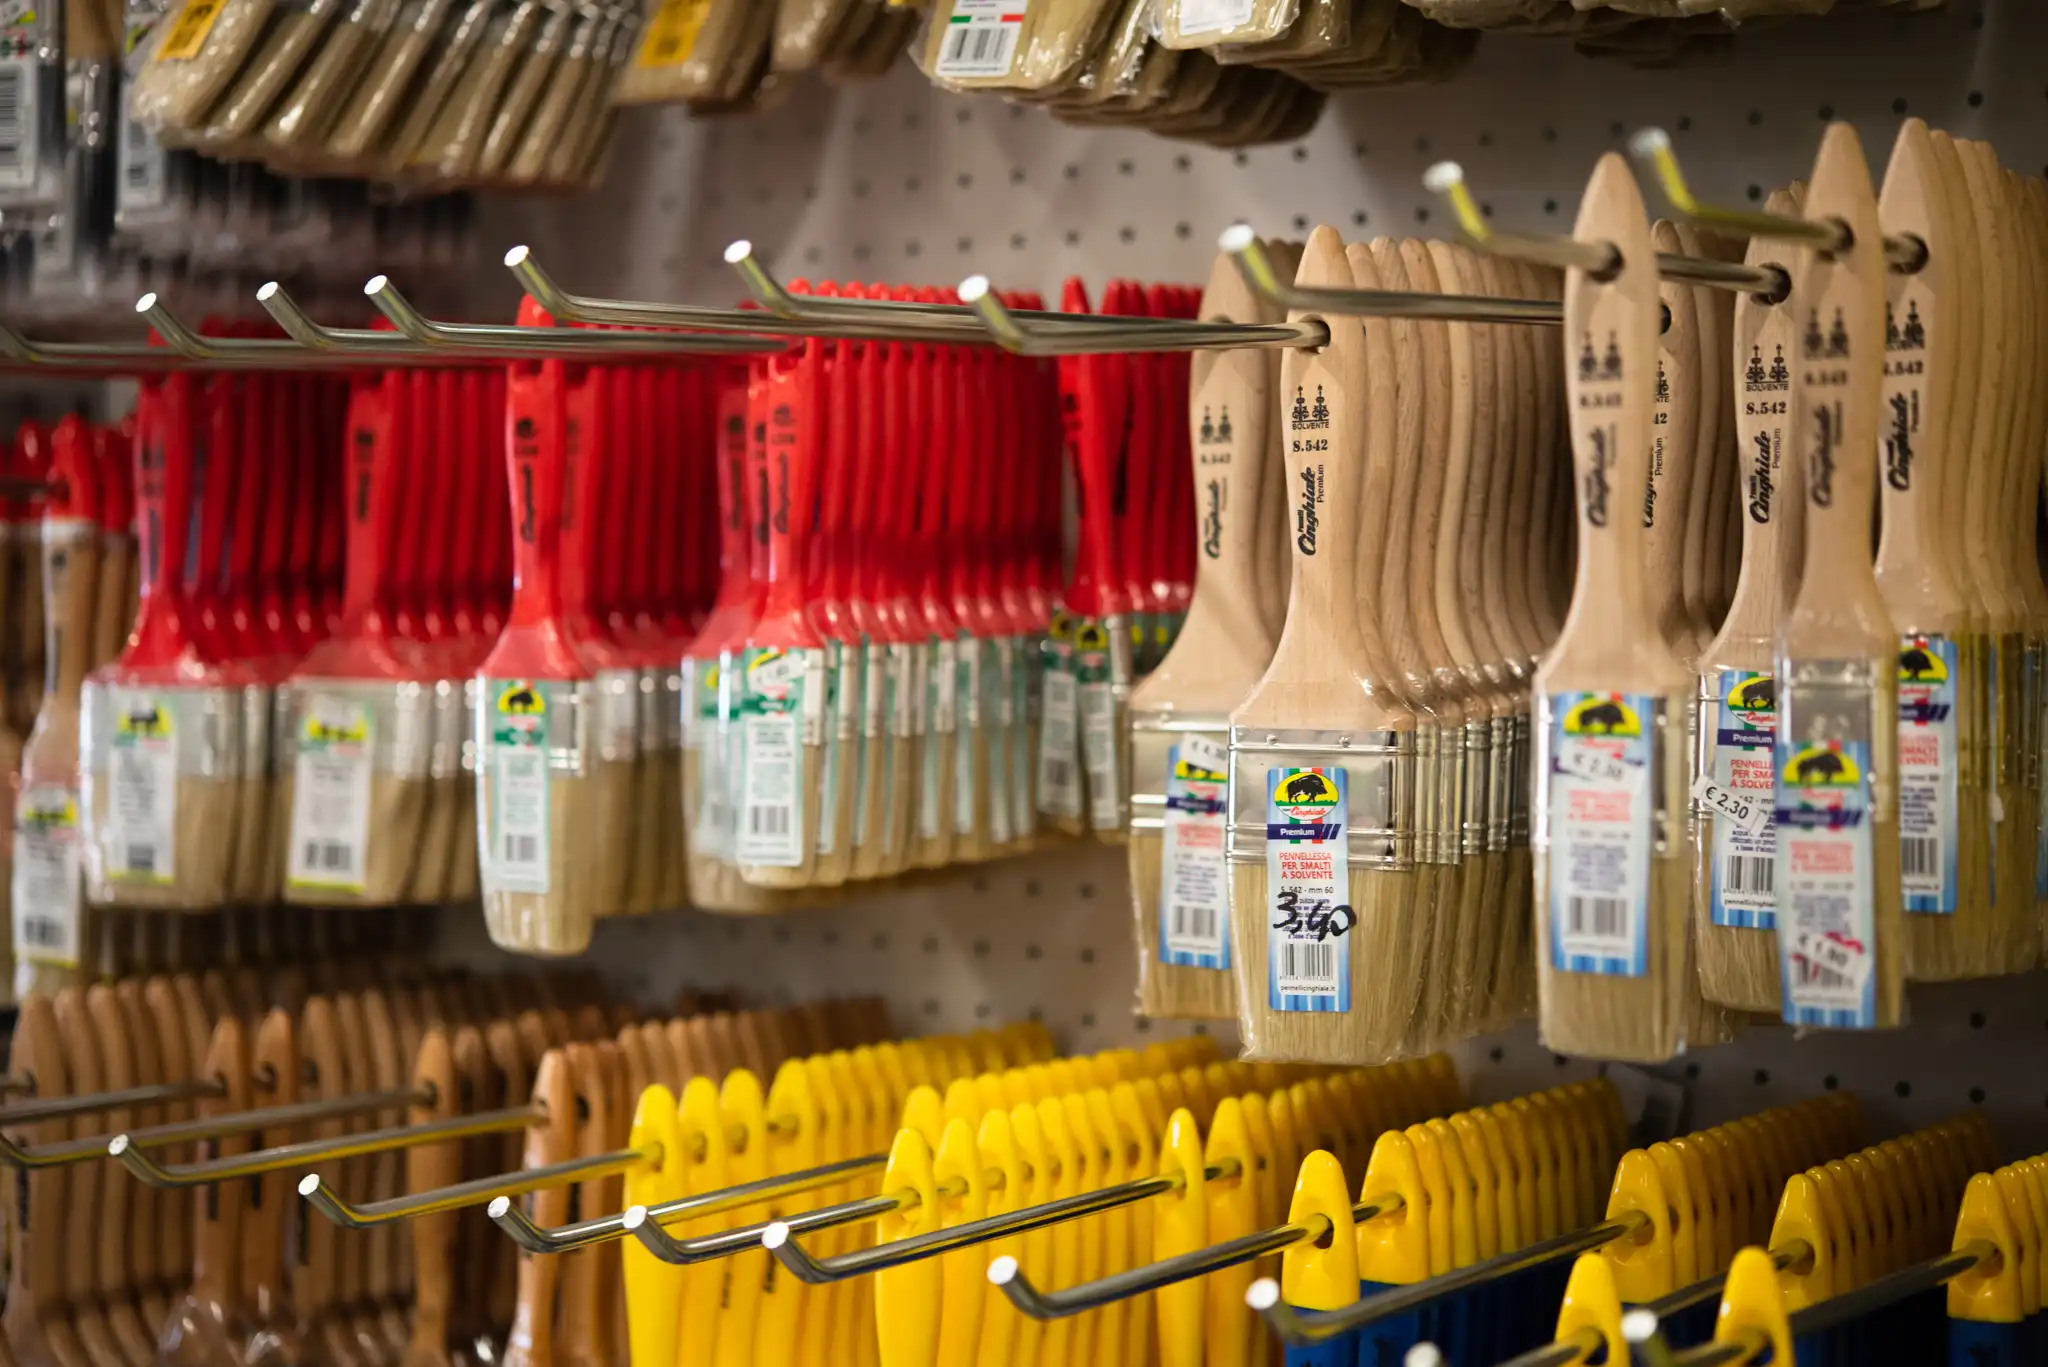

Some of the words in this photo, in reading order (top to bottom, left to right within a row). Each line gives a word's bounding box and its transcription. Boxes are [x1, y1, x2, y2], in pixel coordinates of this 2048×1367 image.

[1746, 401, 1787, 415] S.542
[1293, 438, 1328, 452] S.542
[1772, 427, 1781, 469] Premium
[1655, 437, 1663, 476] Premium
[1733, 733, 1773, 744] Premium
[1731, 769, 1749, 778] PER
[1754, 771, 1775, 779] SMA
[1730, 779, 1738, 788] A
[1705, 786, 1717, 800] €
[1717, 793, 1749, 820] 2,30
[1280, 828, 1315, 836] Premium
[1280, 852, 1332, 860] PENNELLESSA
[1282, 861, 1298, 870] PER
[1300, 861, 1331, 870] SMALTI
[1281, 871, 1288, 879] A
[1290, 871, 1333, 879] SOLVENTE
[1325, 886, 1334, 894] 60
[1272, 891, 1357, 942] 3,40
